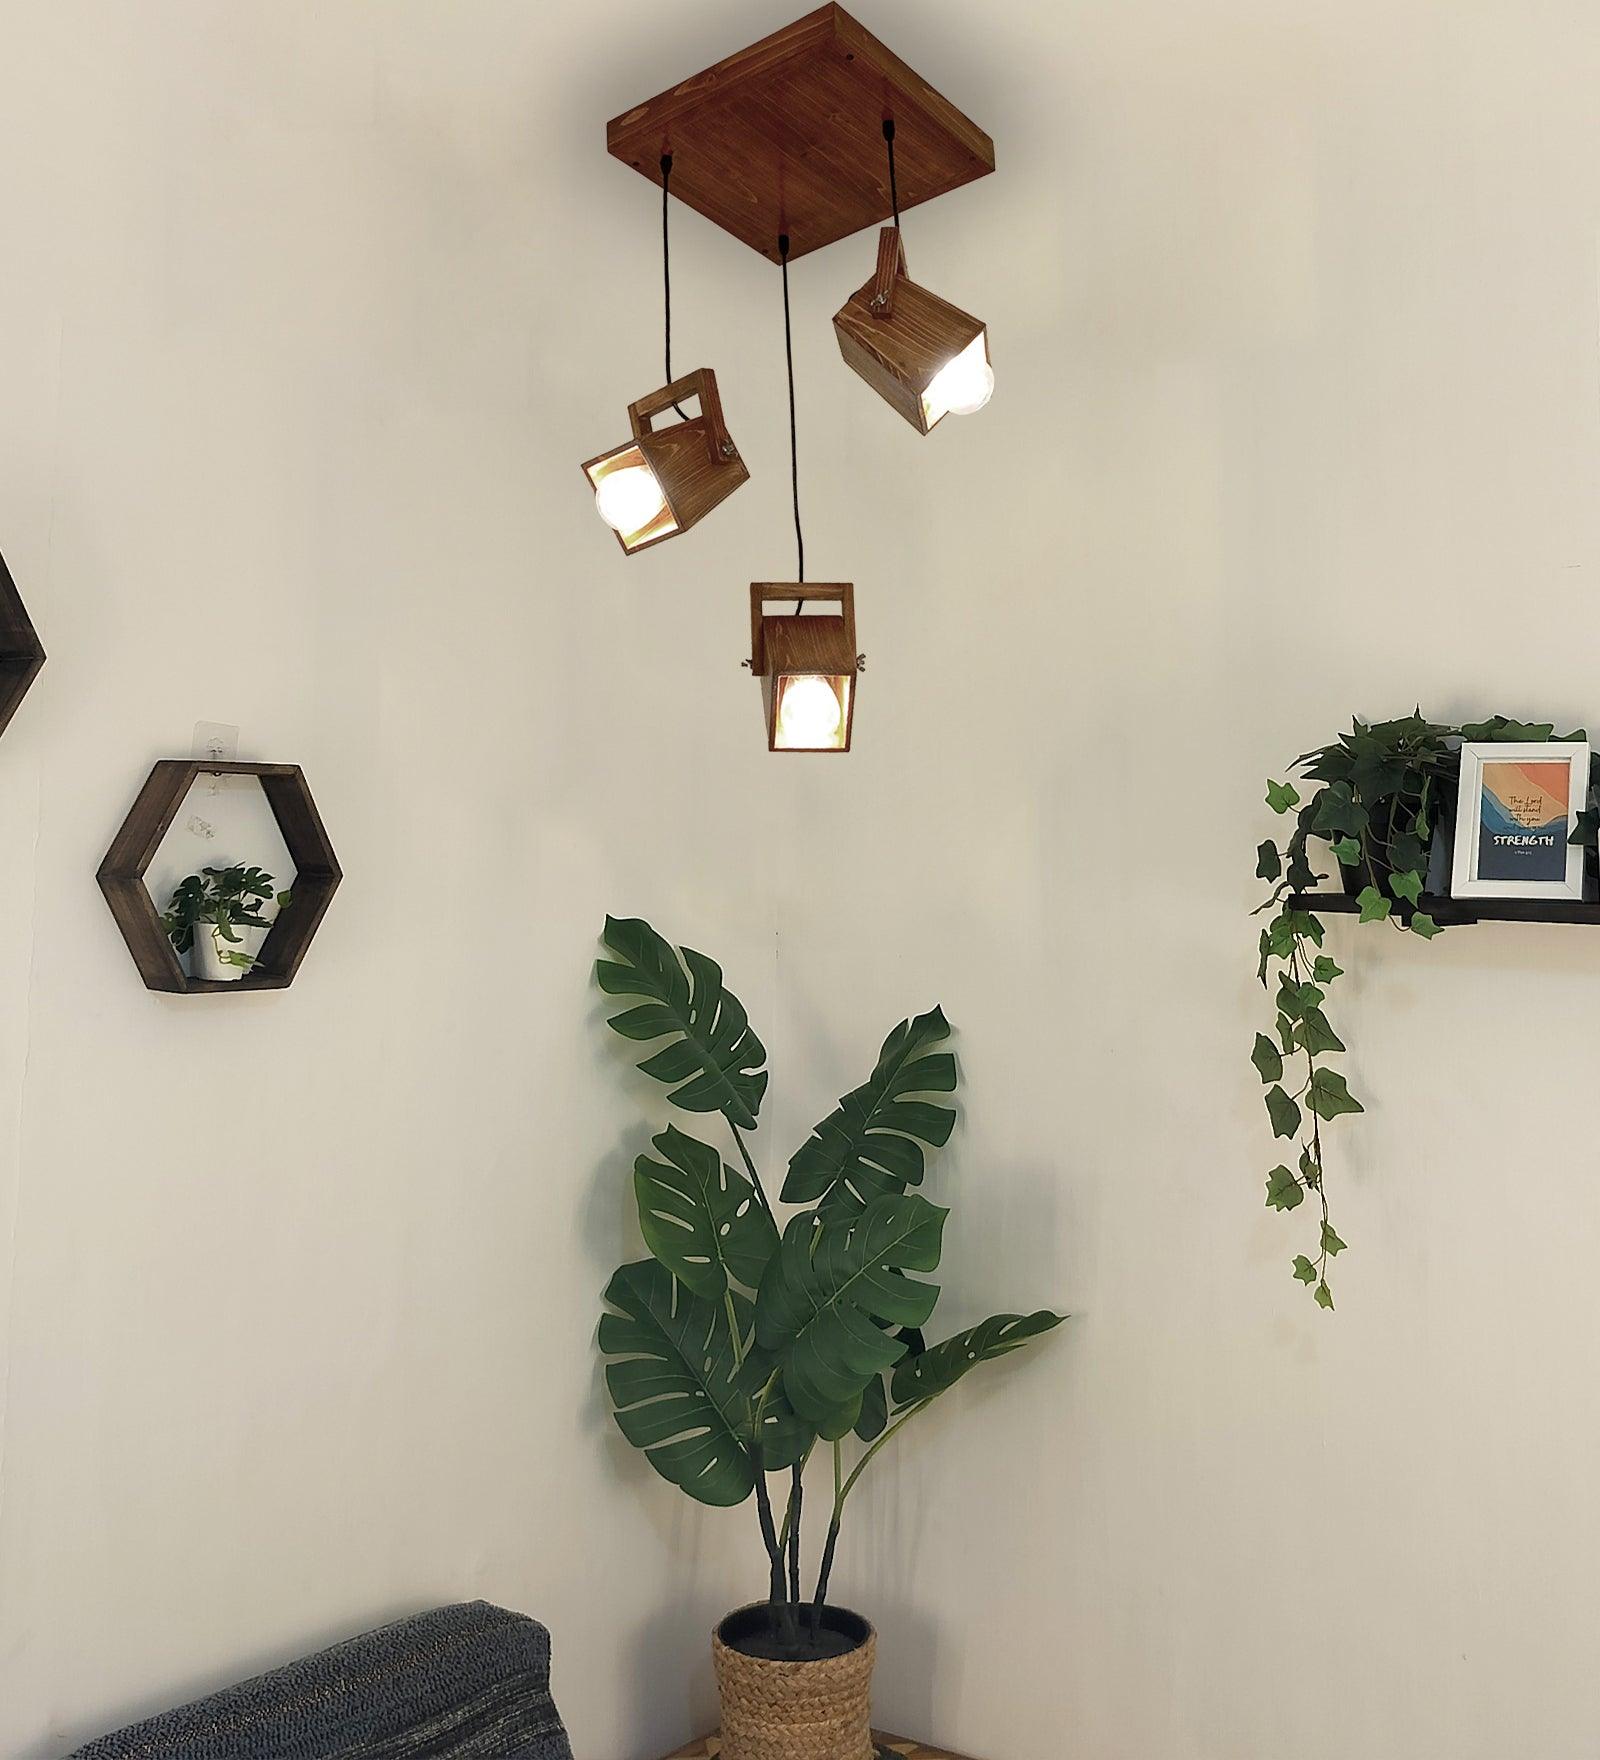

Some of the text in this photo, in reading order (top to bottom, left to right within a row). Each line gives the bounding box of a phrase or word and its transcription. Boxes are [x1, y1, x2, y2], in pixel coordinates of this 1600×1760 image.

[1509, 796, 1543, 806] The Lord
[1493, 835, 1554, 846] STRENGTH
